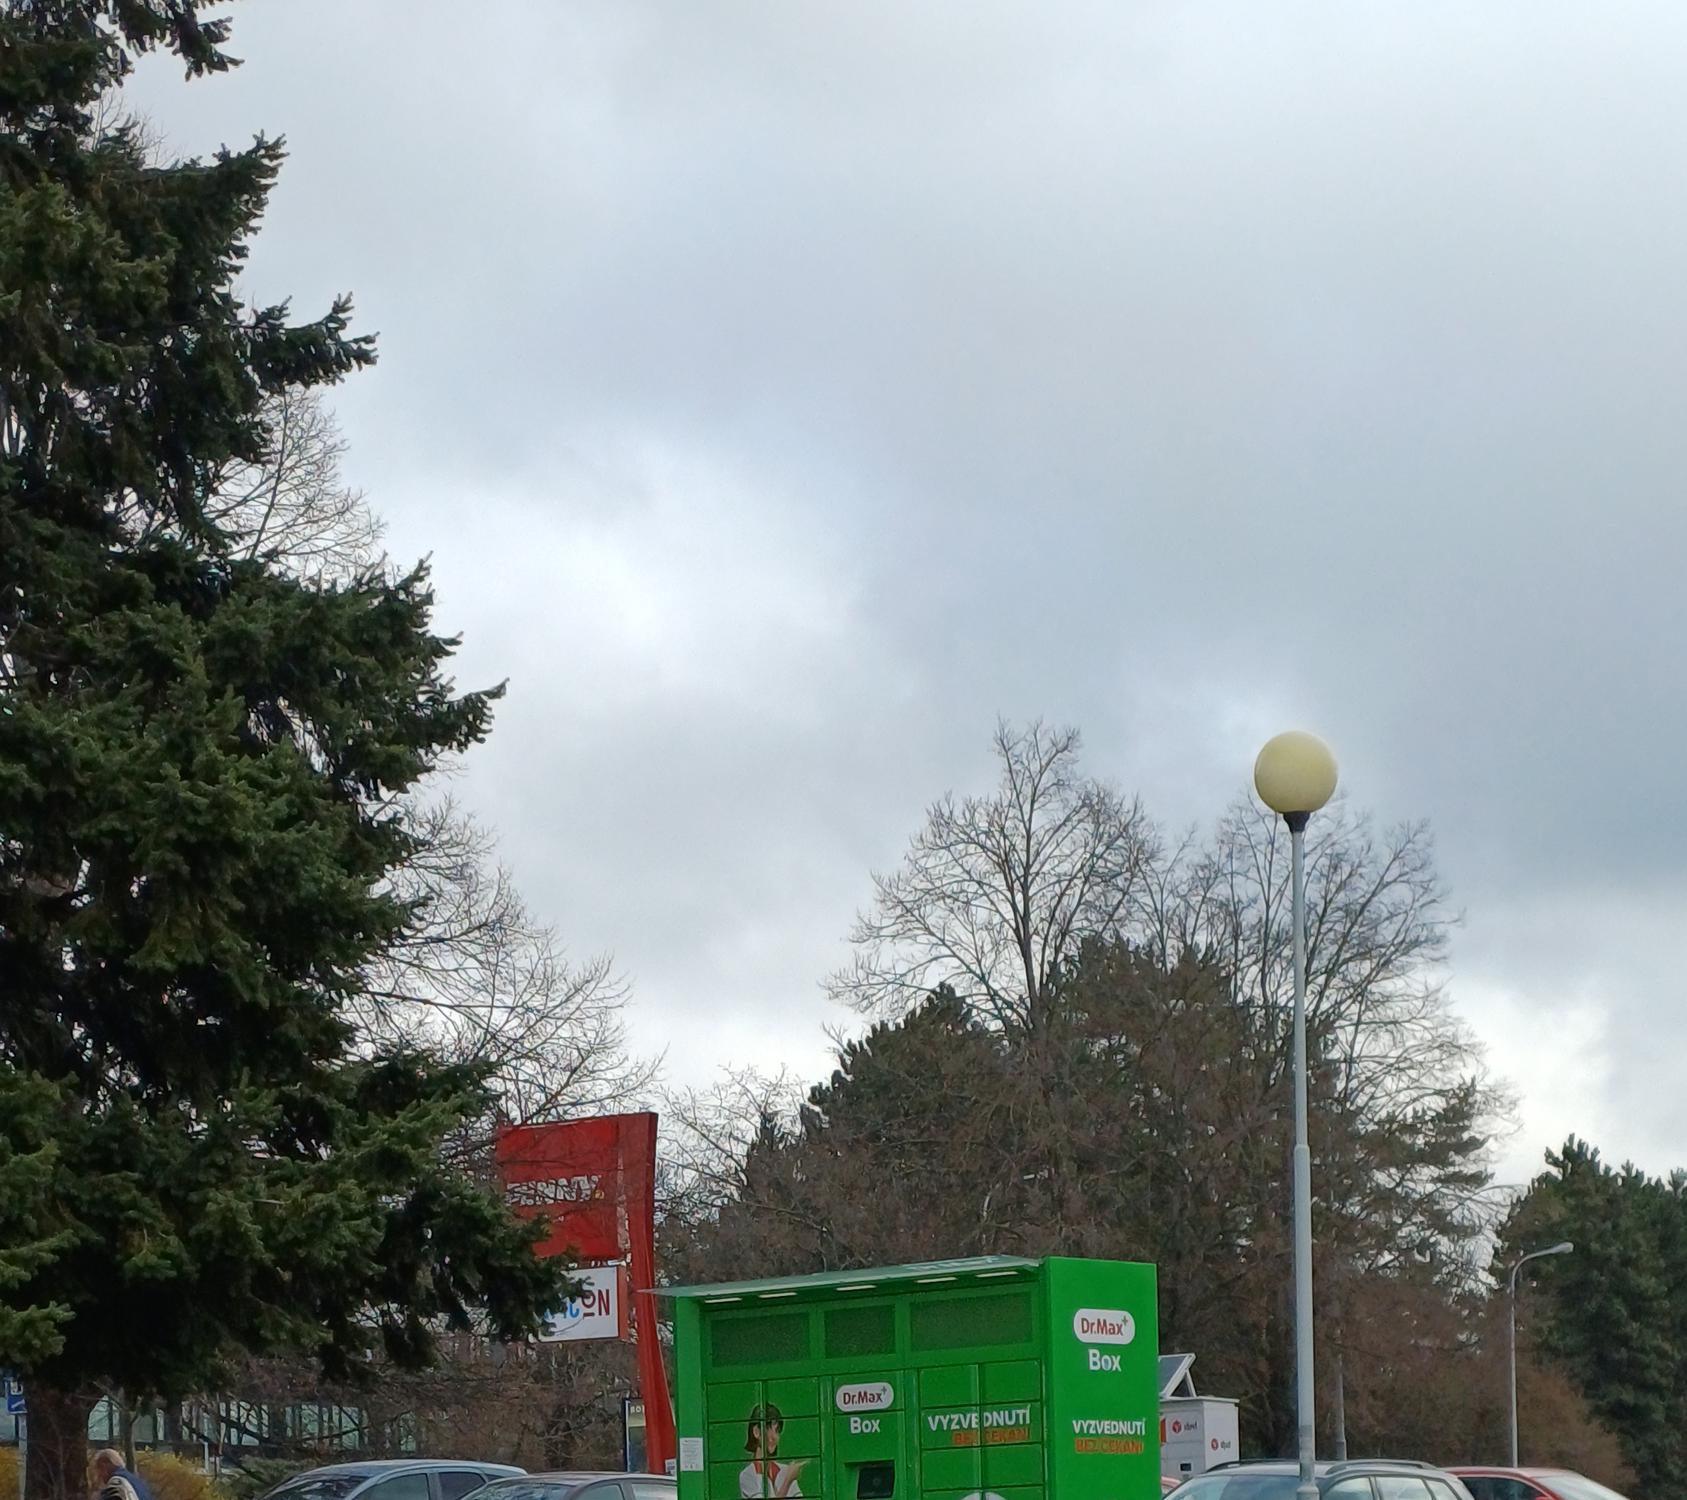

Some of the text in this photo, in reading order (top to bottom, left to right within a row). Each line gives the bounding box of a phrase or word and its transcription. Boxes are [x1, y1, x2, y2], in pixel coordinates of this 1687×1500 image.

[1088, 1349, 1122, 1372] Box
[849, 1416, 881, 1434] Box
[928, 1404, 1032, 1432] VYZVEDNUTÍ
[1072, 1417, 1146, 1436] VYZVEDNUTÍ
